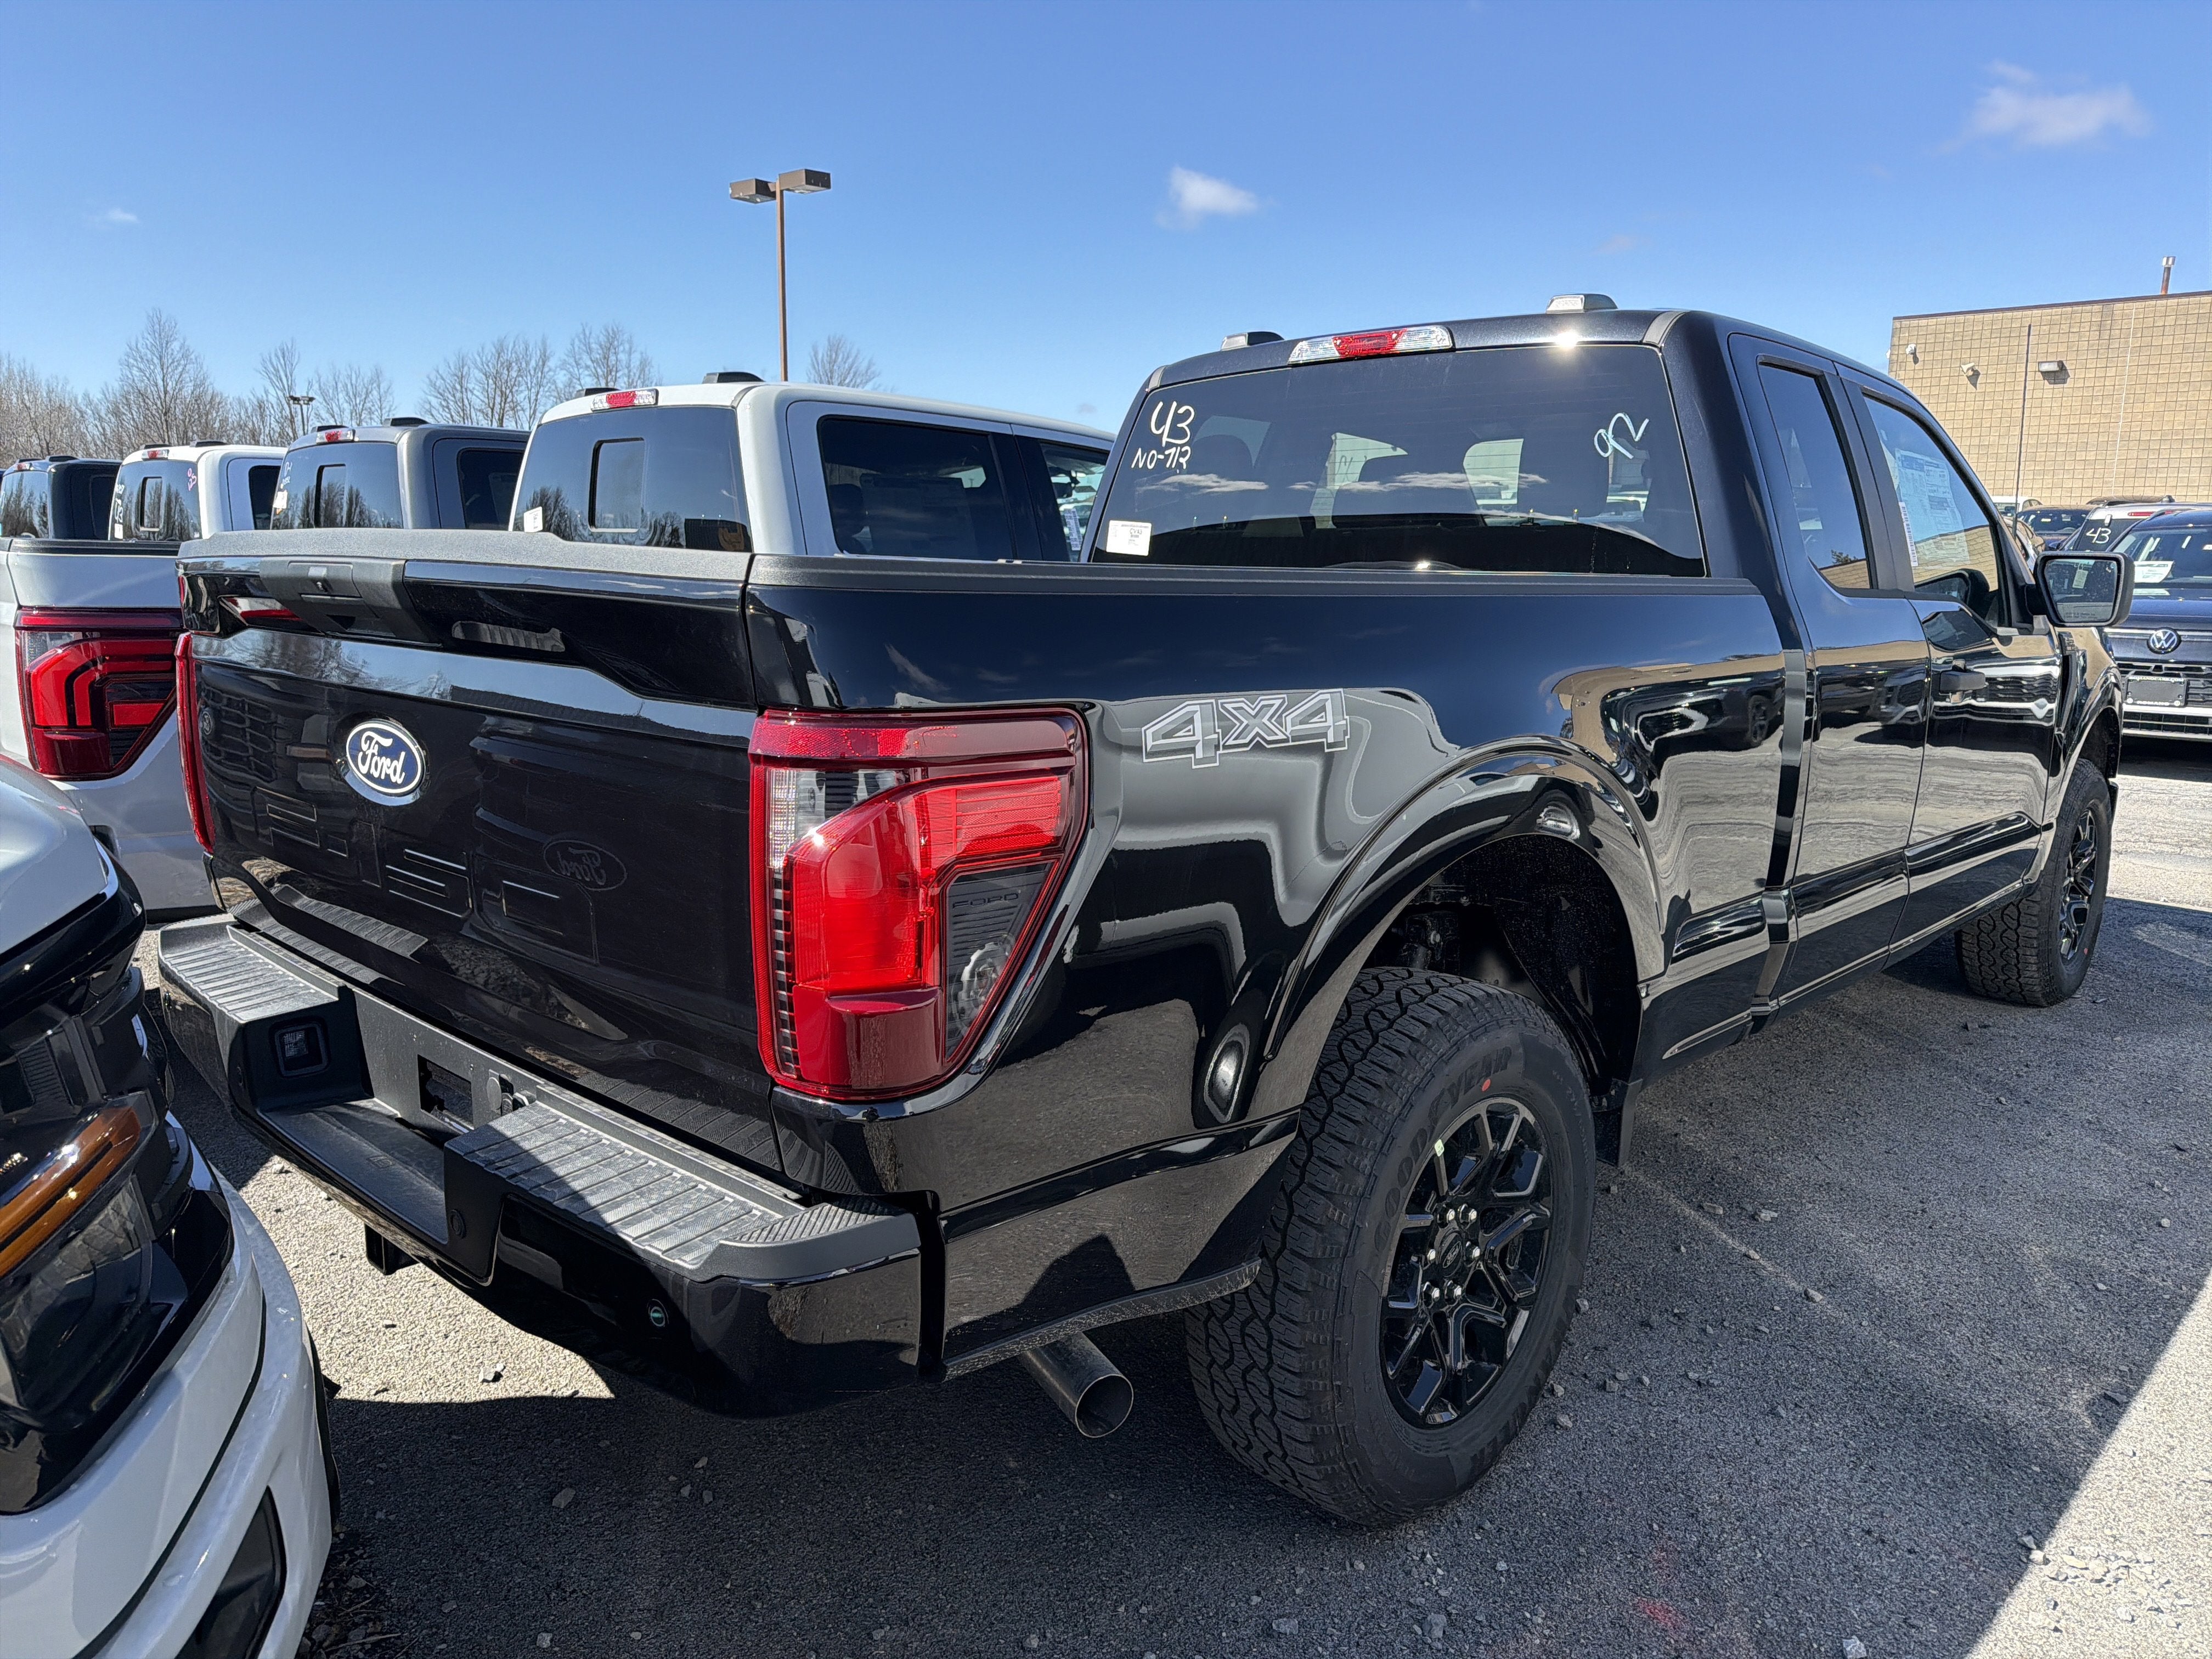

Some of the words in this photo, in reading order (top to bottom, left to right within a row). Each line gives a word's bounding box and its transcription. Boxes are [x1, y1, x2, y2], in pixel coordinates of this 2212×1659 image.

[1151, 401, 1195, 447] 43
[2086, 527, 2112, 544] 43
[358, 731, 406, 784] Ford
[952, 892, 1019, 909] FORD
